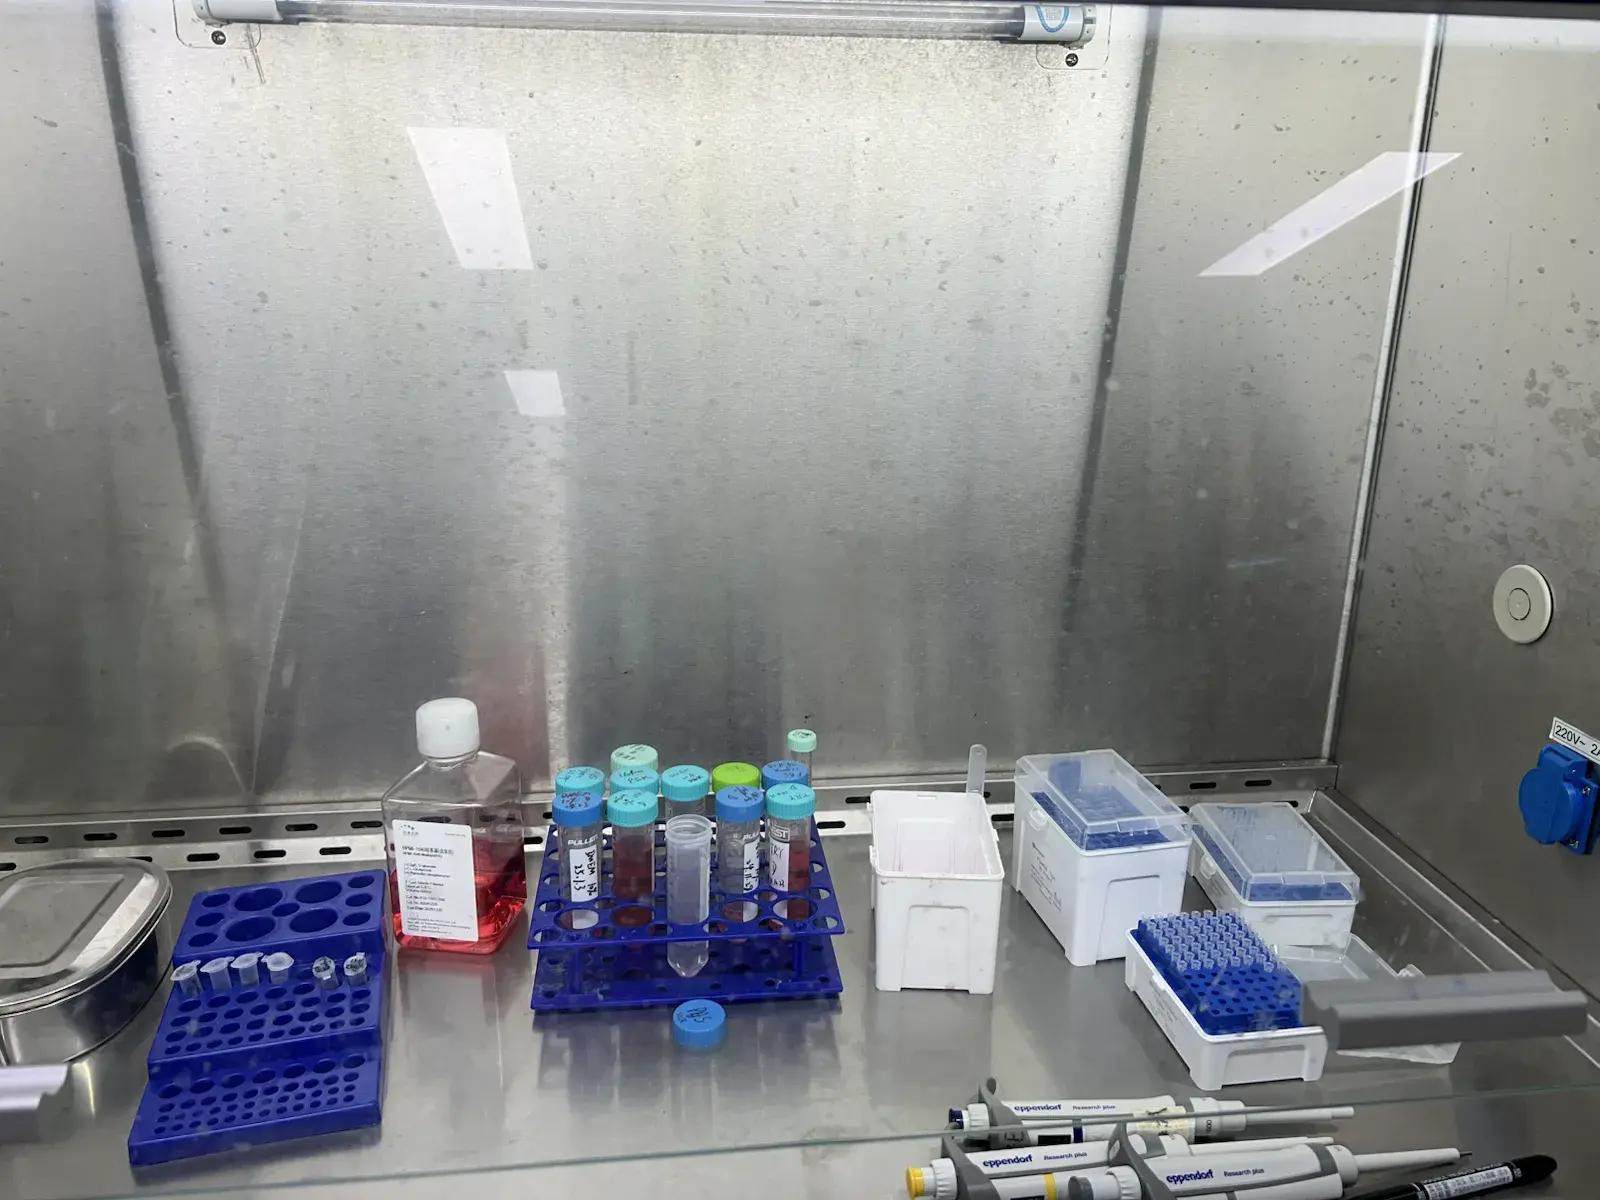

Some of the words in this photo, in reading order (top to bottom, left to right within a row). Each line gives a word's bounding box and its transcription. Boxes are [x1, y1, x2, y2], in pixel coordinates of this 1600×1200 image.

[1014, 1104, 1062, 1113] eppendorf
[982, 1154, 1033, 1168] eppendorf
[1043, 1153, 1073, 1161] Research
[1074, 1151, 1088, 1159] plus
[1166, 1169, 1214, 1185] eppendorf
[1223, 1169, 1252, 1178] Research
[1252, 1167, 1265, 1176] plus
